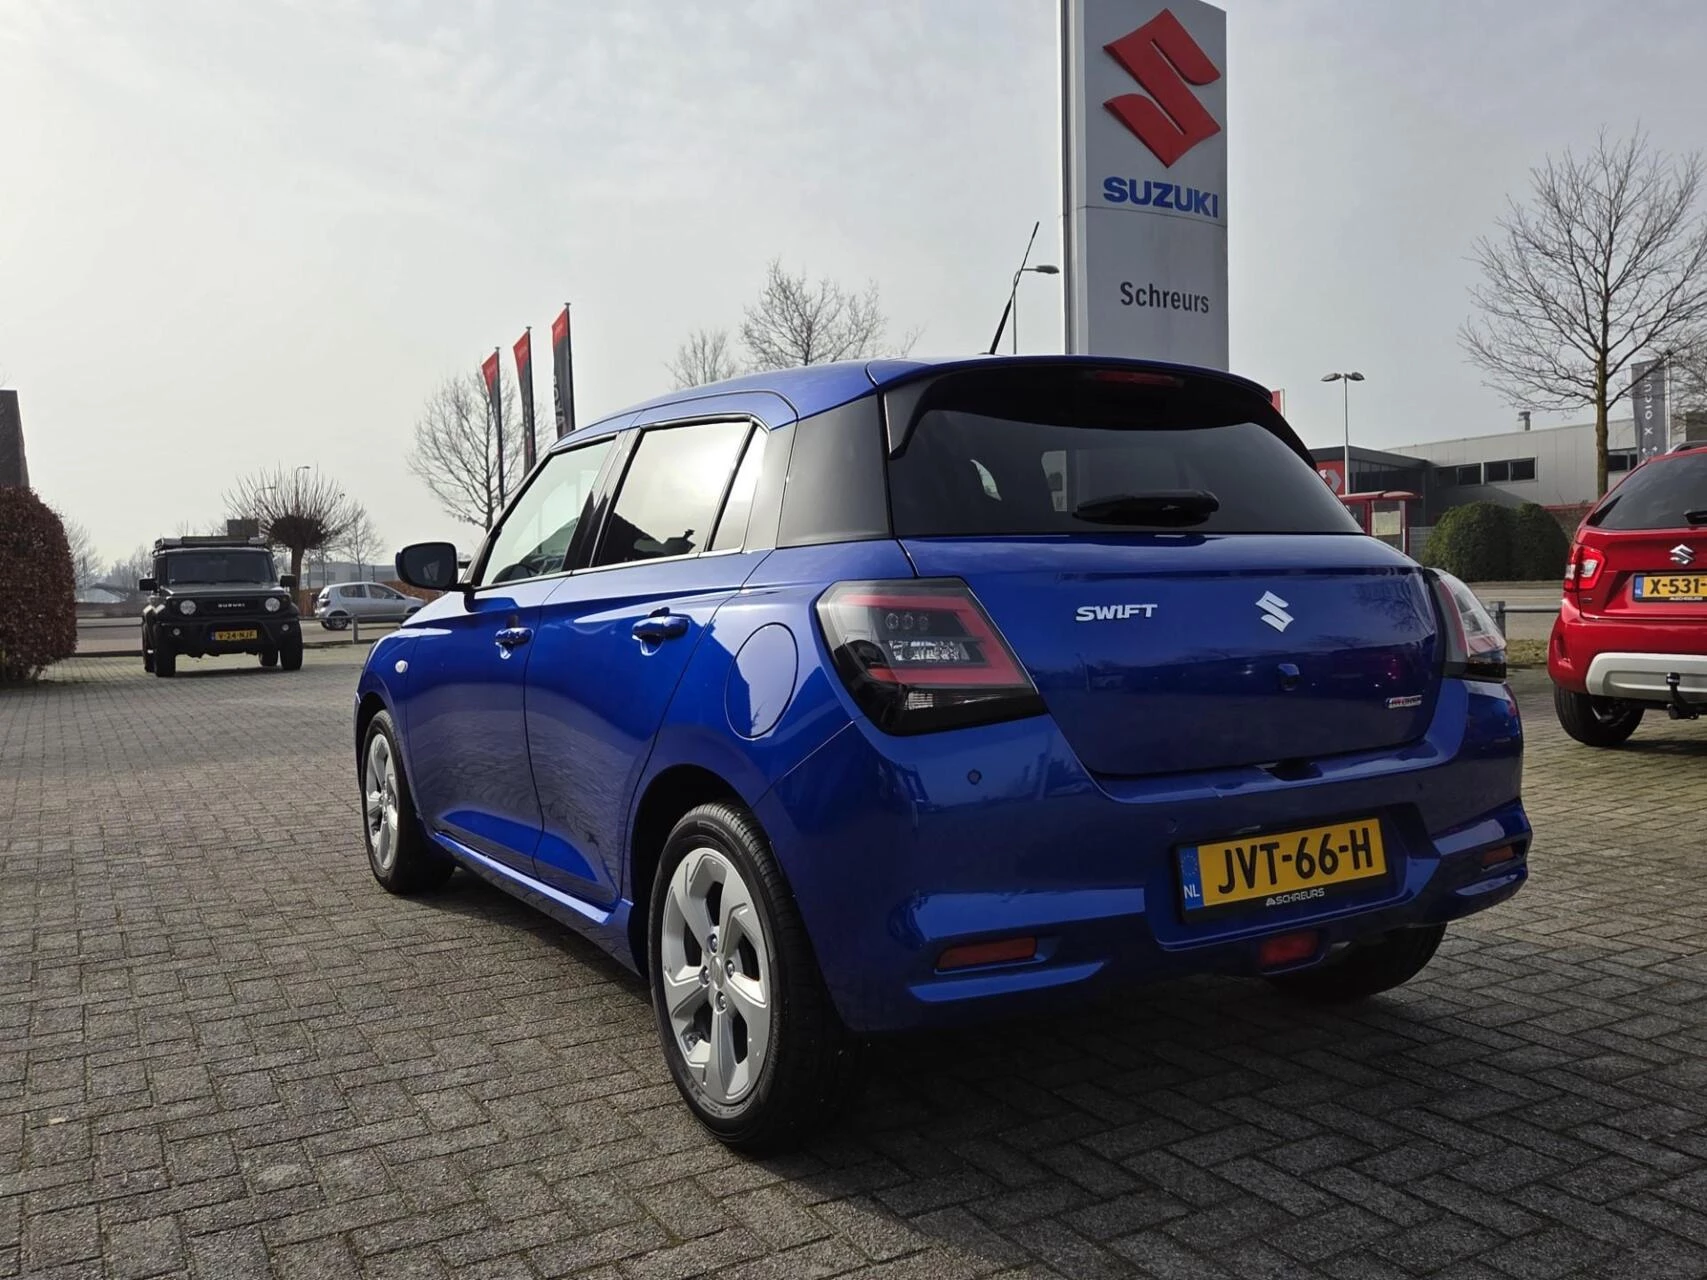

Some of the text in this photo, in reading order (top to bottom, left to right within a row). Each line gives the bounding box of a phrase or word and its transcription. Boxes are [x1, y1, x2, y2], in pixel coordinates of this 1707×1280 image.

[1103, 176, 1218, 219] SUZUKI
[1120, 282, 1209, 314] Schreurs
[1075, 604, 1158, 621] SWIFT
[1218, 827, 1373, 895] JVT-66-H
[1183, 885, 1200, 900] NL
[1275, 887, 1325, 905] SCHREURS
